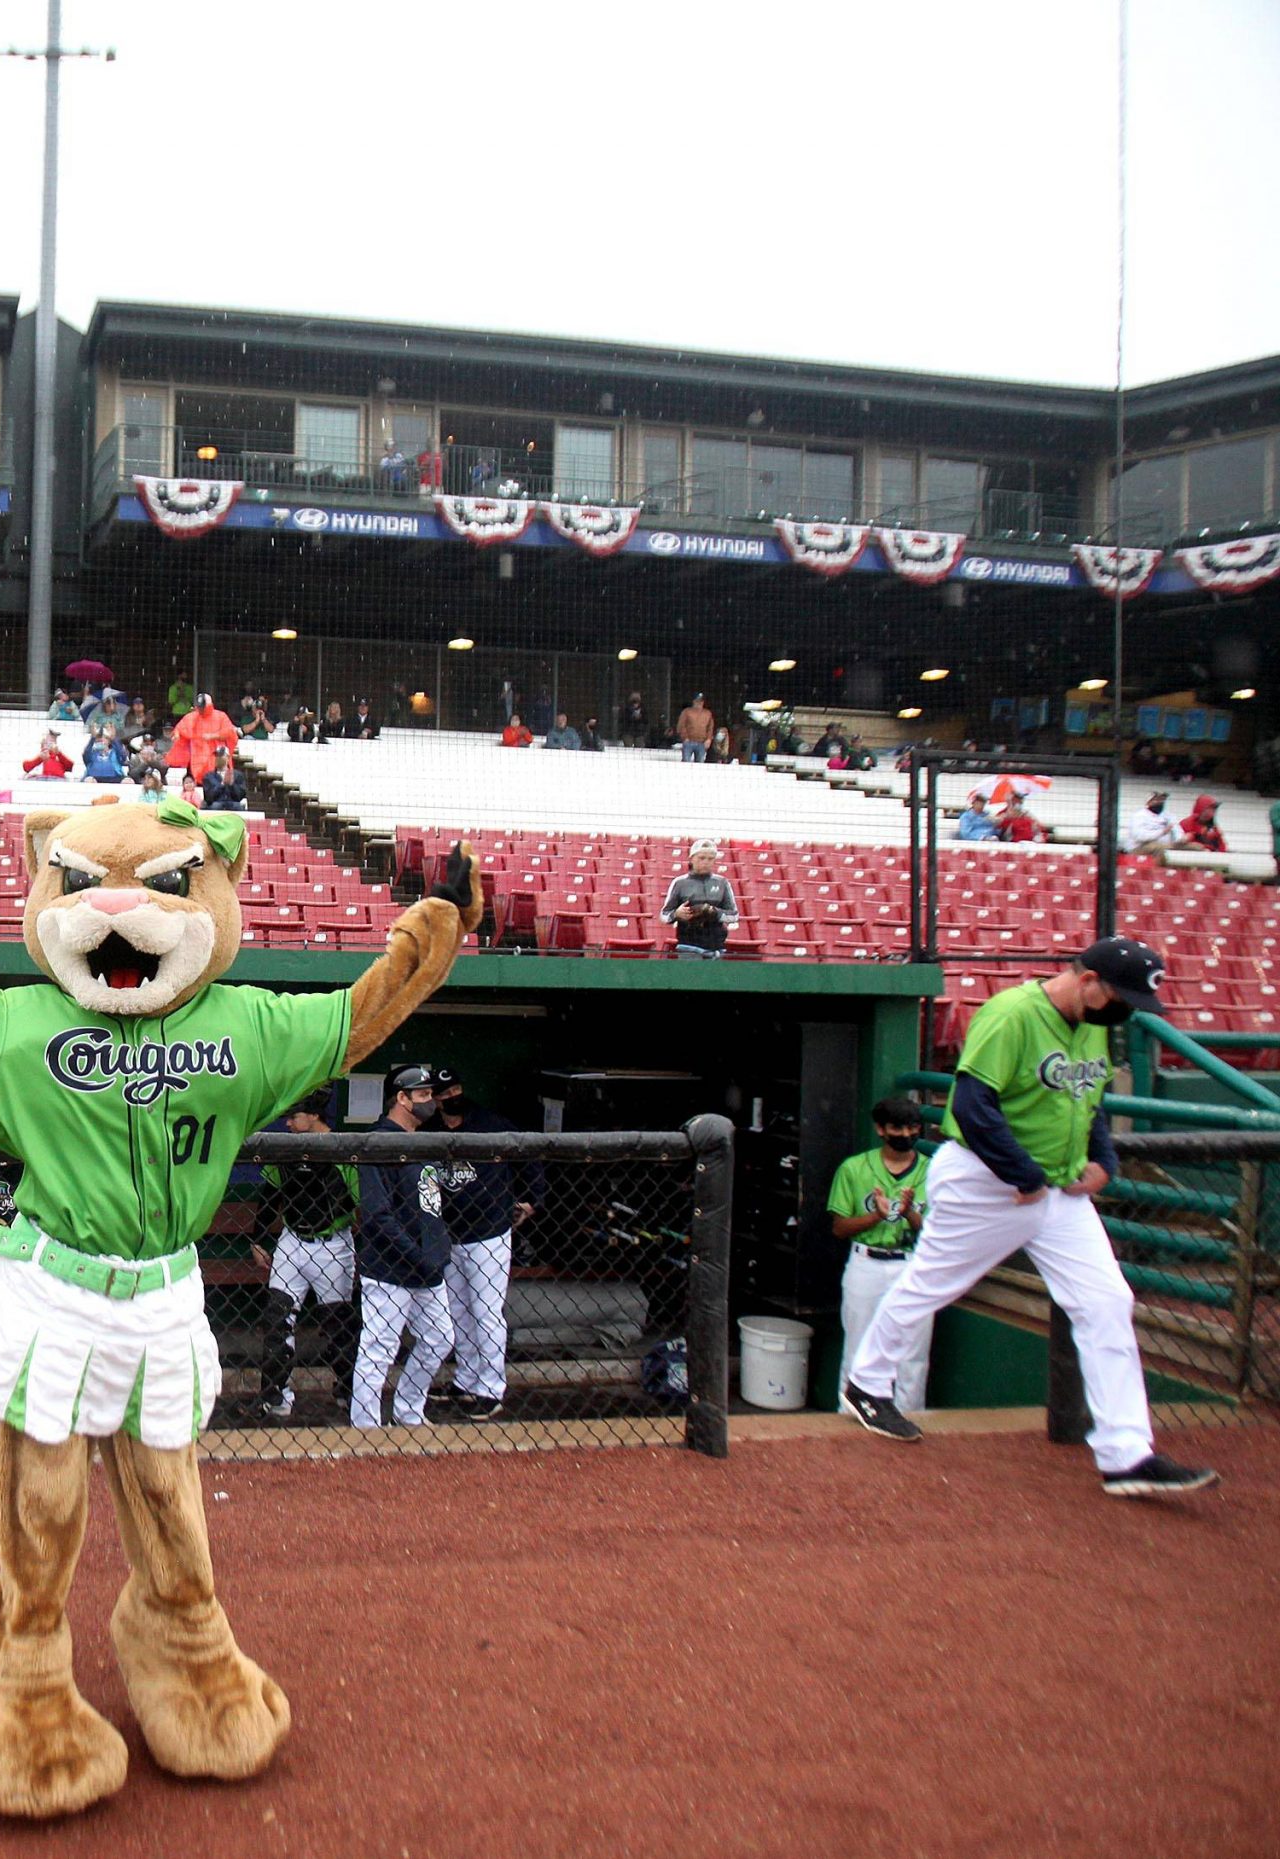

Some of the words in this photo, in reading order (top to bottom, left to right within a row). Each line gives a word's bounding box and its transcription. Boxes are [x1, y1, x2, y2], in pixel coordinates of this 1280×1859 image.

[331, 511, 419, 536] HYUNDAI
[685, 534, 765, 559] HYUNDAI
[993, 560, 1070, 585] HYUNDAI
[45, 1026, 238, 1106] Cougars
[172, 1114, 217, 1167] 01
